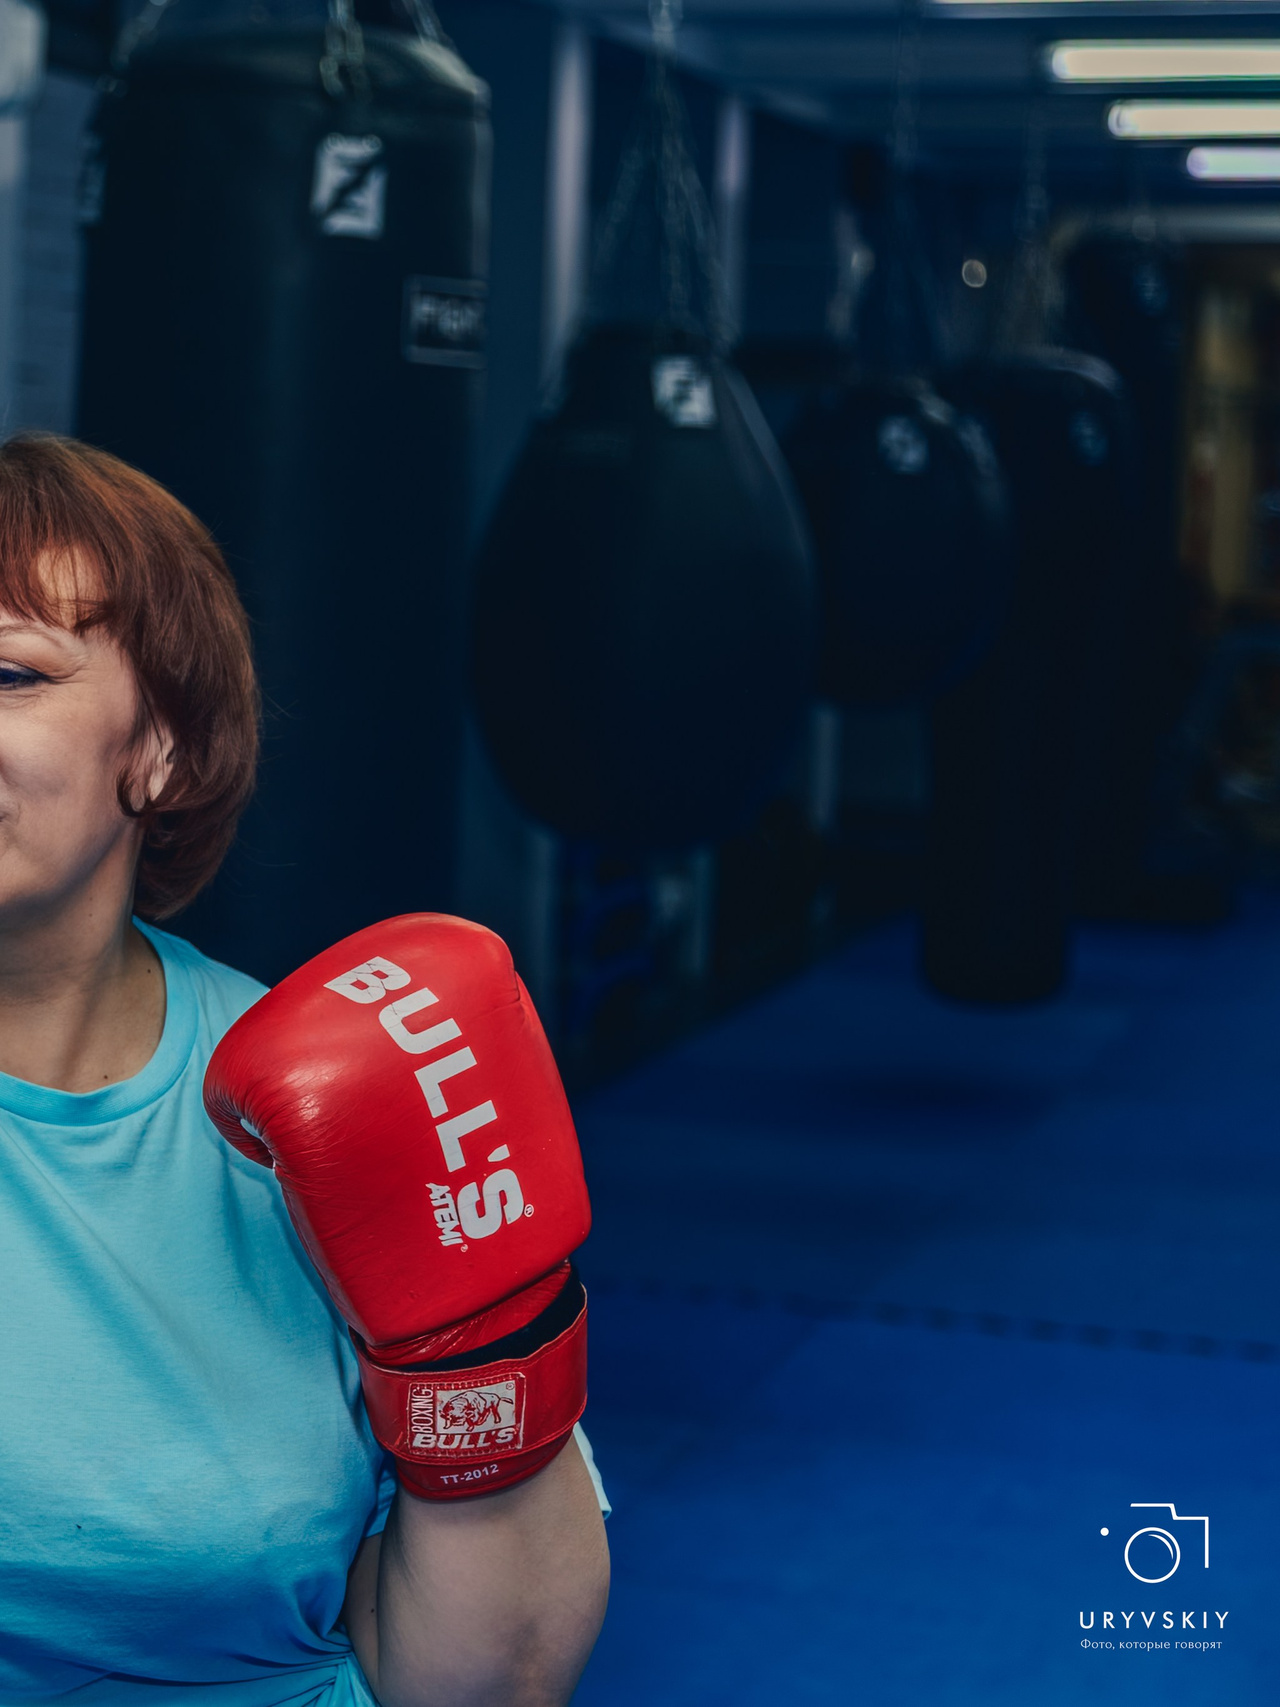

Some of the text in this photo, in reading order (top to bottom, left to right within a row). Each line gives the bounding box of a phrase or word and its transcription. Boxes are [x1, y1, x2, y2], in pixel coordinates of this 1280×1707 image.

[323, 956, 524, 1239] BULL'S
[425, 1182, 464, 1246] ATEMI
[411, 1387, 434, 1435] BOXING
[412, 1427, 516, 1450] BULL'S
[440, 1463, 500, 1486] TT-2012
